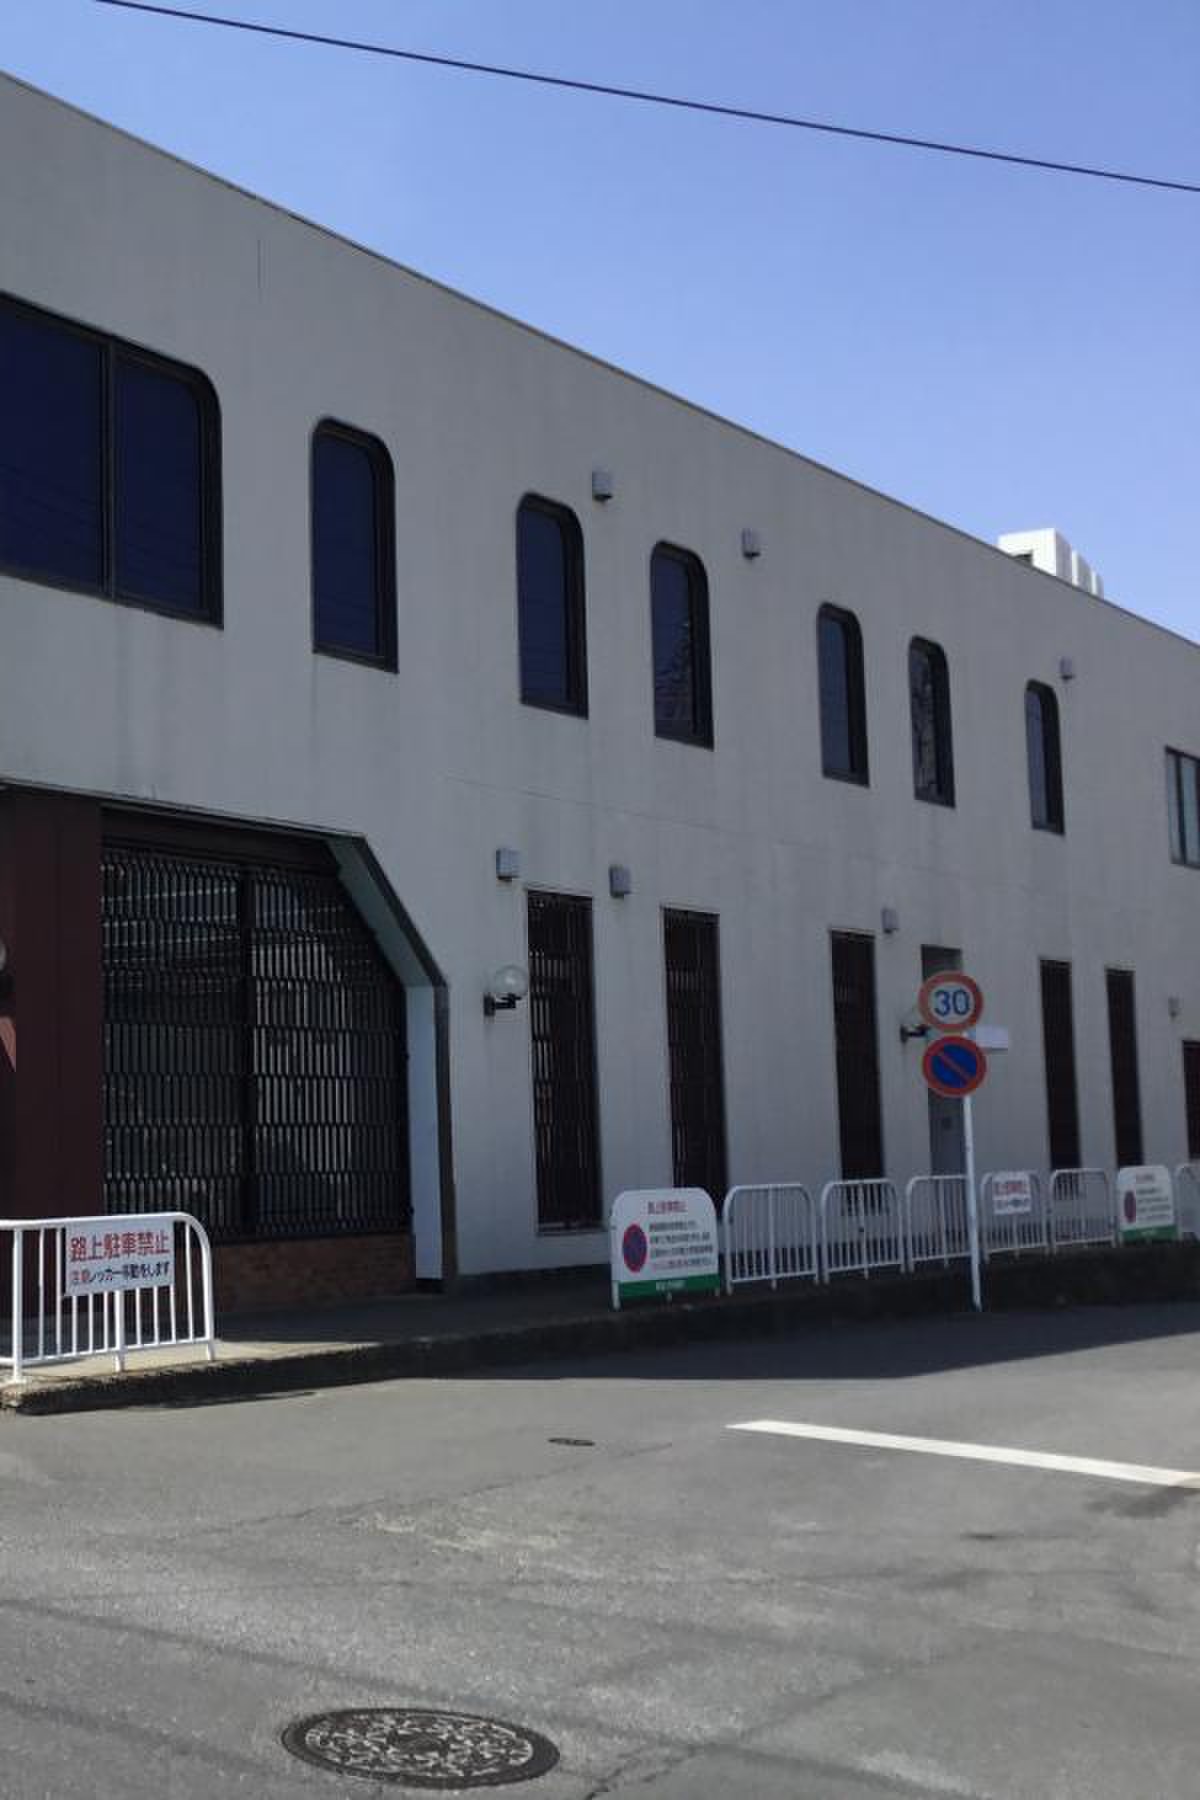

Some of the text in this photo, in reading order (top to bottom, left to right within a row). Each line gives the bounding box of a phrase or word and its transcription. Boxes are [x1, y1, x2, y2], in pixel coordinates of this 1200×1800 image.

[934, 989, 970, 1016] 30
[71, 1230, 171, 1262] 路上駐車禁止
